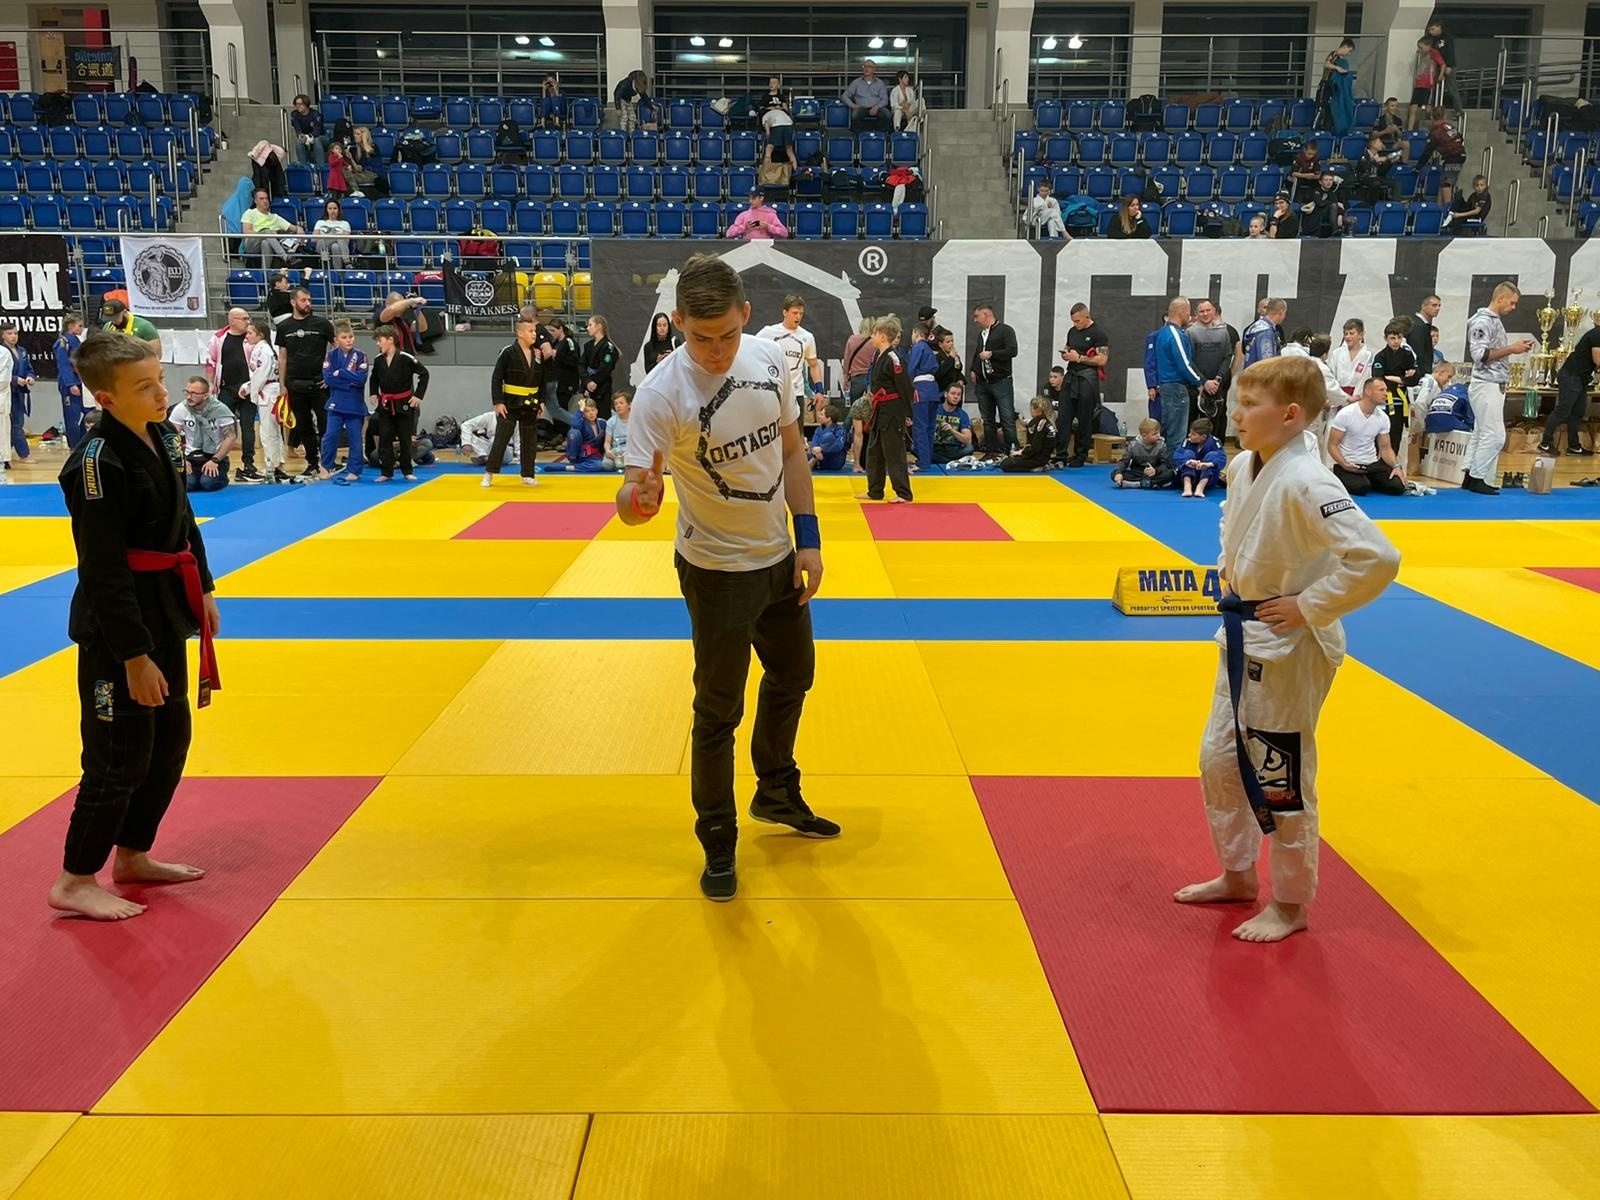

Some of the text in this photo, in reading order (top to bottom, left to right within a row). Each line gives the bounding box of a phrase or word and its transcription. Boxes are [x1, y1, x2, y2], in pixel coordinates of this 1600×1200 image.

[446, 304, 519, 316] HE WEAKNESS
[931, 238, 1600, 438] OCTAG
[1138, 569, 1222, 603] MATA 4
